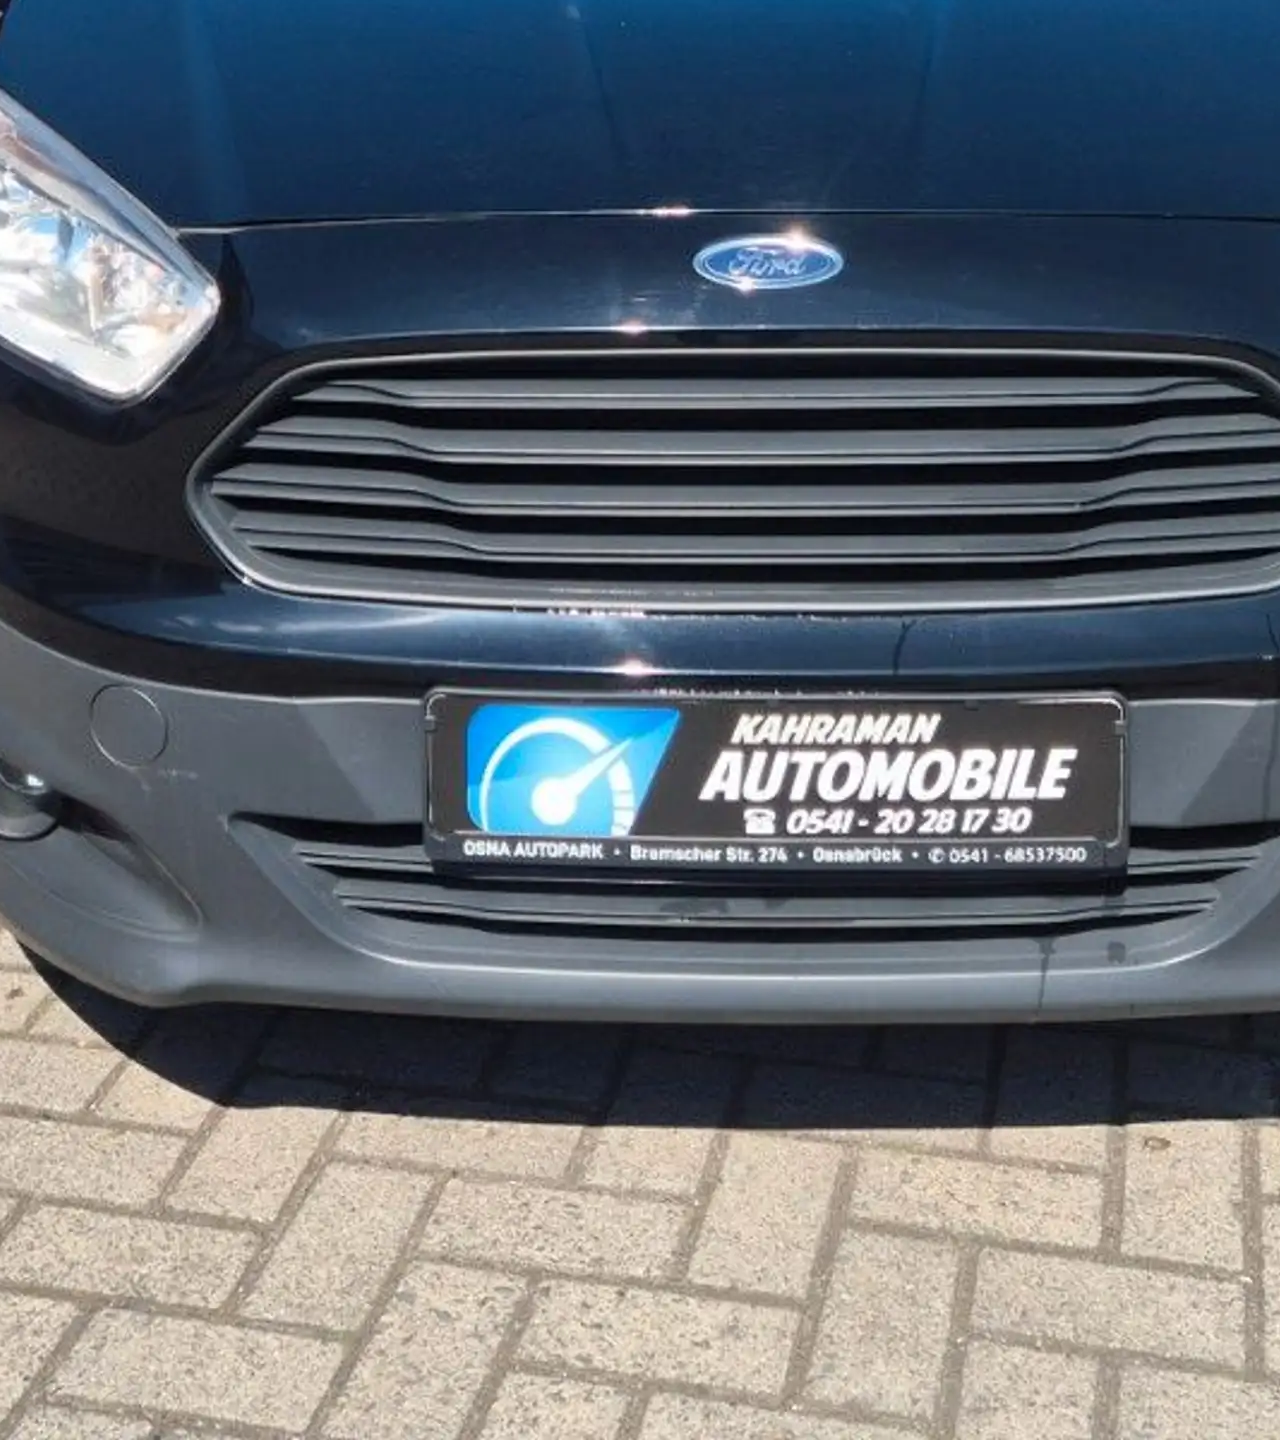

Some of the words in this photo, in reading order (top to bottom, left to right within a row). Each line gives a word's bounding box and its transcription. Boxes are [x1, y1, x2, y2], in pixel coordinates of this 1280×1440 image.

[728, 246, 807, 276] Ford
[731, 713, 941, 745] KAHRAMAN
[698, 748, 1078, 802] AUTOMOBILE
[786, 808, 854, 835] 0541
[874, 808, 915, 835] 20
[918, 808, 957, 834] 28
[961, 808, 991, 834] 17
[992, 807, 1033, 834] 30
[463, 841, 510, 858] OSNA
[514, 843, 603, 859] AUTOPARK
[630, 844, 720, 861] Bramscher
[726, 846, 754, 862] Str.
[949, 848, 988, 864] 0541
[1005, 847, 1088, 863] 68537500
